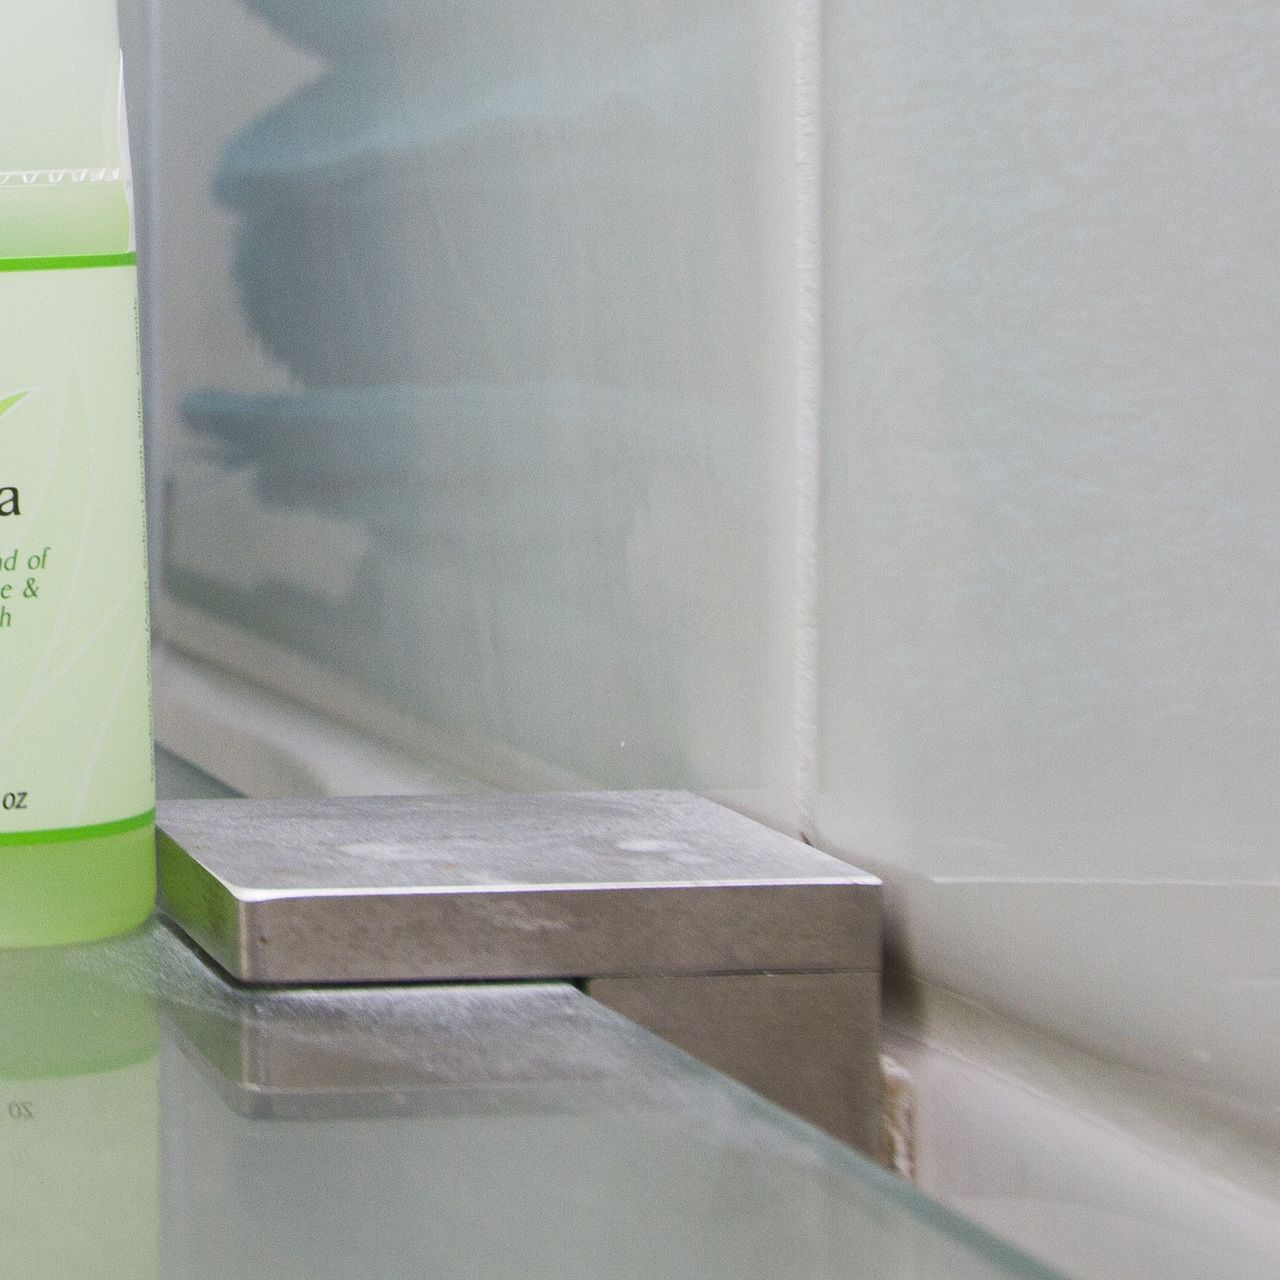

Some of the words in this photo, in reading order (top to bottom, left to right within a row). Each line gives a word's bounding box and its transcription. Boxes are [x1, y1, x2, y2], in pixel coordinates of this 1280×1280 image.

[27, 546, 51, 570] of
[22, 576, 40, 599] &
[2, 791, 28, 811] oz
